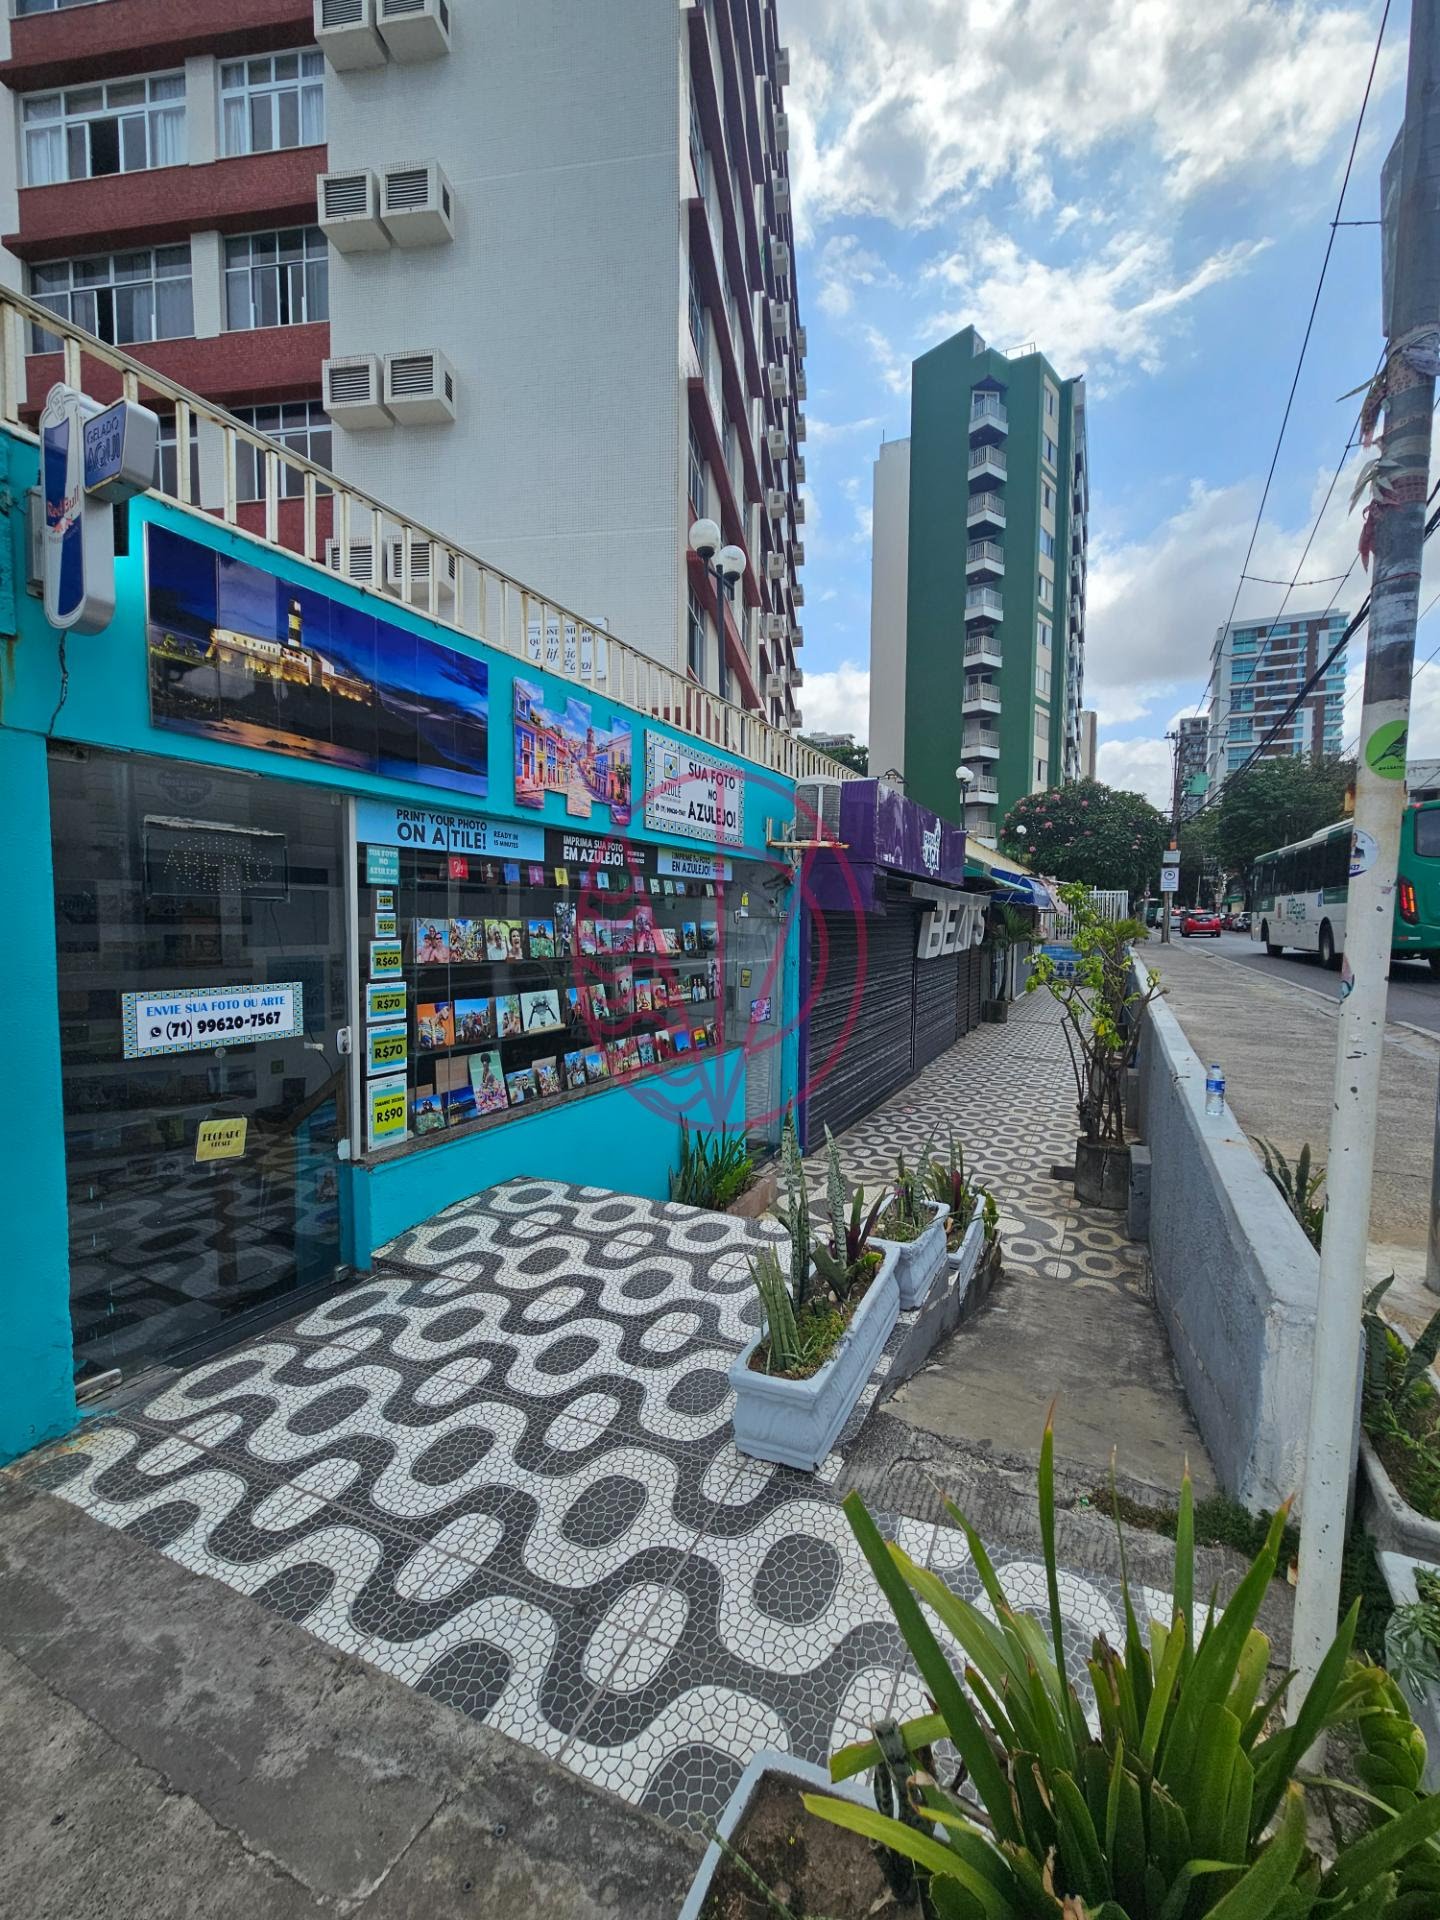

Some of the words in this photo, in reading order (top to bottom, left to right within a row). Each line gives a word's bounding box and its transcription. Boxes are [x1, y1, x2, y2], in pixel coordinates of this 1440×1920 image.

[86, 416, 119, 444] GELADO
[688, 762, 708, 782] SUA
[711, 770, 736, 789] FOTO
[708, 789, 717, 801] NO
[397, 809, 425, 822] PRINT
[428, 813, 455, 828] YOUR
[458, 818, 487, 831] PHOTO
[688, 800, 736, 828] AZULEJO!
[397, 822, 426, 843] ON
[432, 827, 445, 846] A
[451, 829, 487, 850] TILE!
[493, 830, 512, 840] READY
[499, 840, 519, 849] MINUTES
[563, 835, 592, 849] IMPRIMA
[594, 840, 606, 850] SUA
[607, 842, 623, 853] FOTO
[563, 846, 578, 862] EM
[580, 848, 624, 866] AZULEJO!
[672, 861, 680, 872] EN
[681, 863, 711, 877] AZULEJO!
[917, 900, 985, 959] BEATS
[376, 956, 399, 967] R$60
[146, 1004, 181, 1016] ENVIE
[185, 1002, 208, 1013] SUA
[211, 1000, 240, 1011] FOTO
[243, 998, 258, 1008] OU
[261, 996, 285, 1006] ARTE
[377, 999, 400, 1009] R$70
[166, 1019, 193, 1040] (71)
[197, 1011, 280, 1034] 99620-7567
[375, 1044, 403, 1059] R$70
[376, 1106, 403, 1123] R$90
